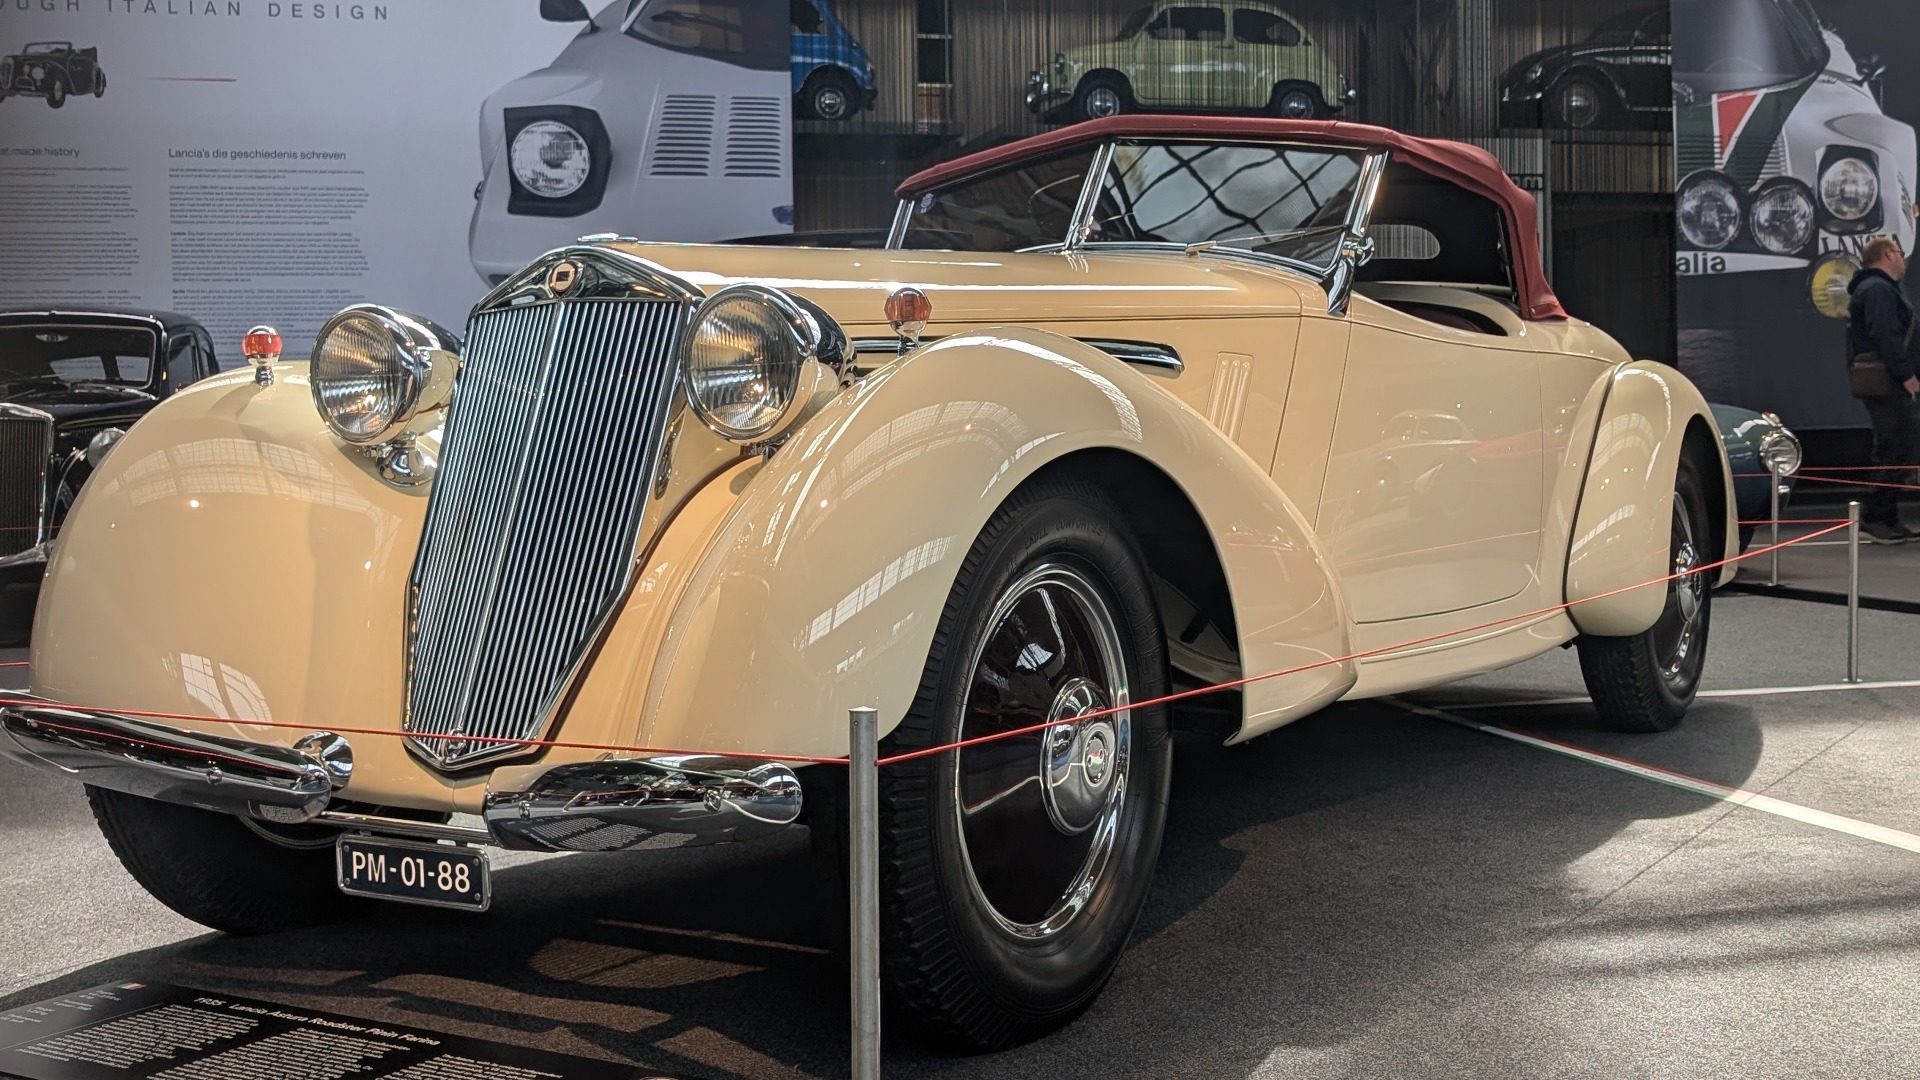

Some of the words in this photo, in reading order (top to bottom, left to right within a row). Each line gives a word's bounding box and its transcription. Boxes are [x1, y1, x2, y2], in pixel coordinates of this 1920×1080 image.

[0, 0, 79, 11] UGH
[108, 0, 241, 16] ITALIAN
[269, 2, 389, 20] DESIGN
[44, 147, 80, 158] history
[169, 148, 210, 159] Lancia's
[212, 148, 227, 159] die
[229, 149, 298, 162] geschiedenis
[300, 151, 347, 161] schreven
[1676, 252, 1726, 273] alia
[352, 851, 471, 893] PM-01-88
[229, 1003, 268, 1015] Lancia
[267, 1010, 309, 1022] Astura
[309, 1017, 367, 1032] Roadster
[398, 1034, 441, 1046] Farina
